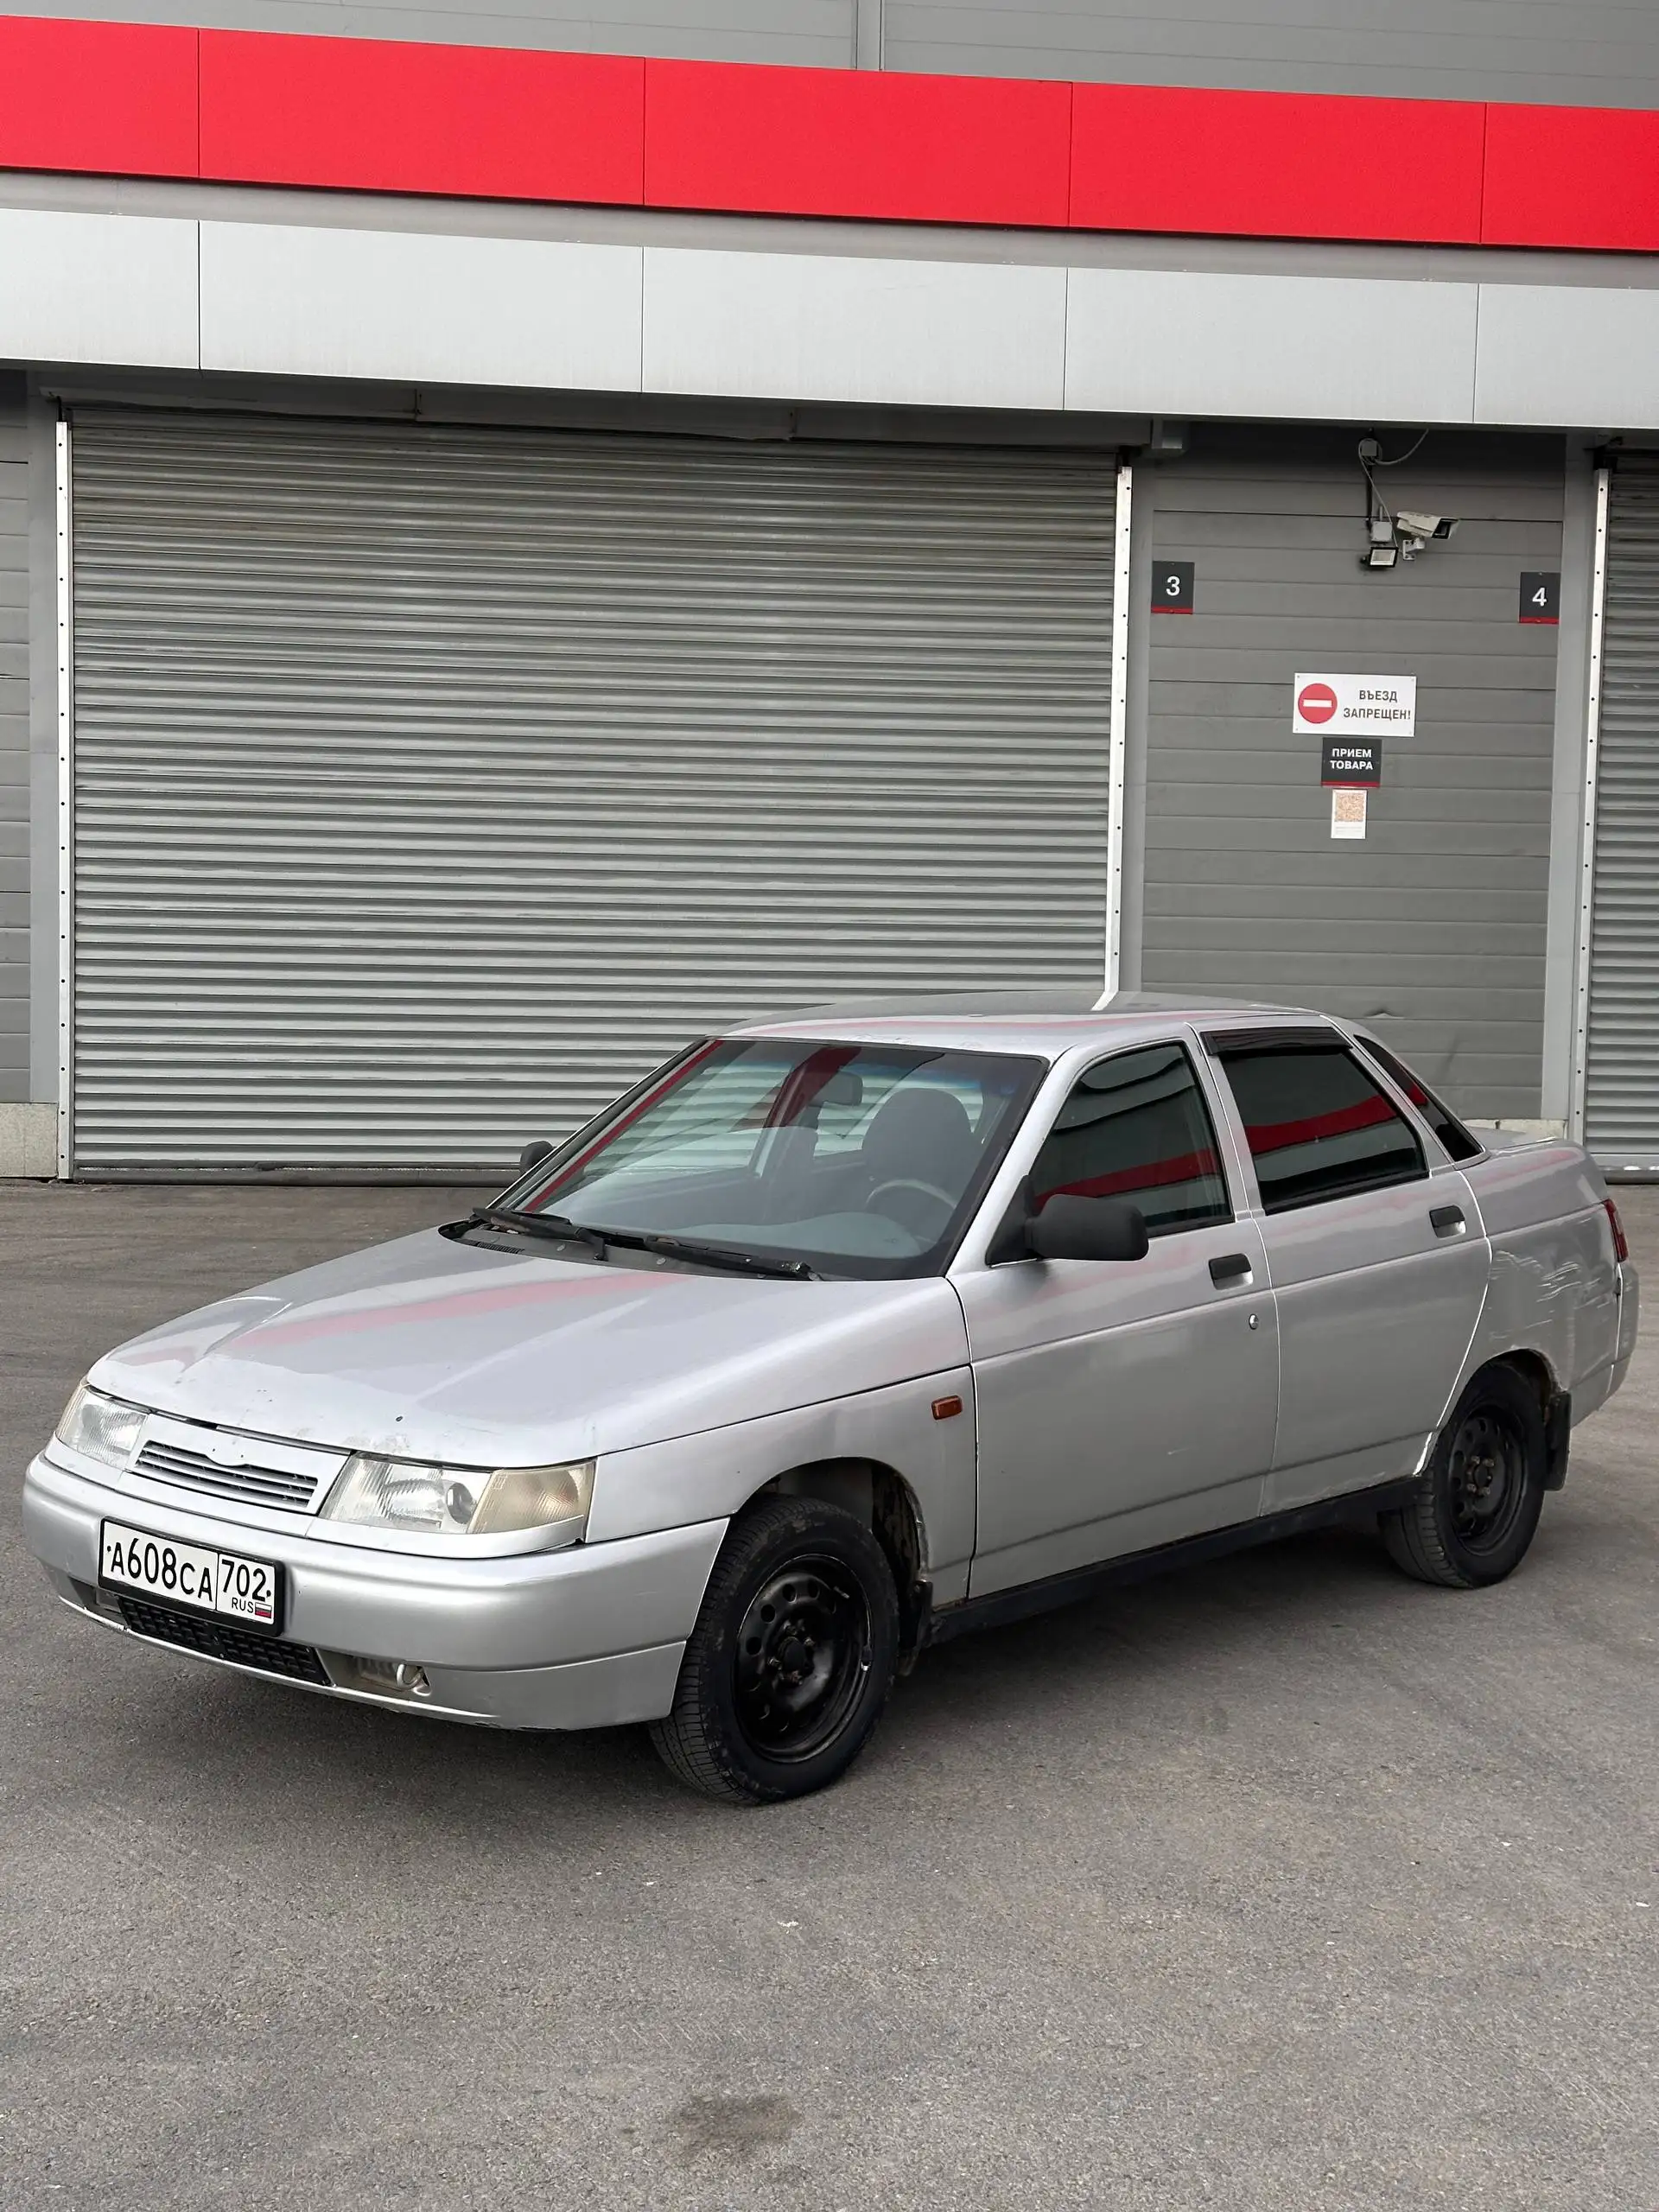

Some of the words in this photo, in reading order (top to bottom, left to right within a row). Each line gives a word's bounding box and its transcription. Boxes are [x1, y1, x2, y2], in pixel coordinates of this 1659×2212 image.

[1166, 575, 1180, 596] 3
[1532, 588, 1548, 607] 4
[1359, 690, 1398, 702] ВЪЕЗД
[1344, 708, 1411, 721] ЗАПРЕЩЕН!
[1332, 748, 1372, 758] ПРИЕМ
[1330, 760, 1373, 770] ТОВАРА
[221, 1559, 266, 1601] 702
[232, 1597, 254, 1613] RUS
